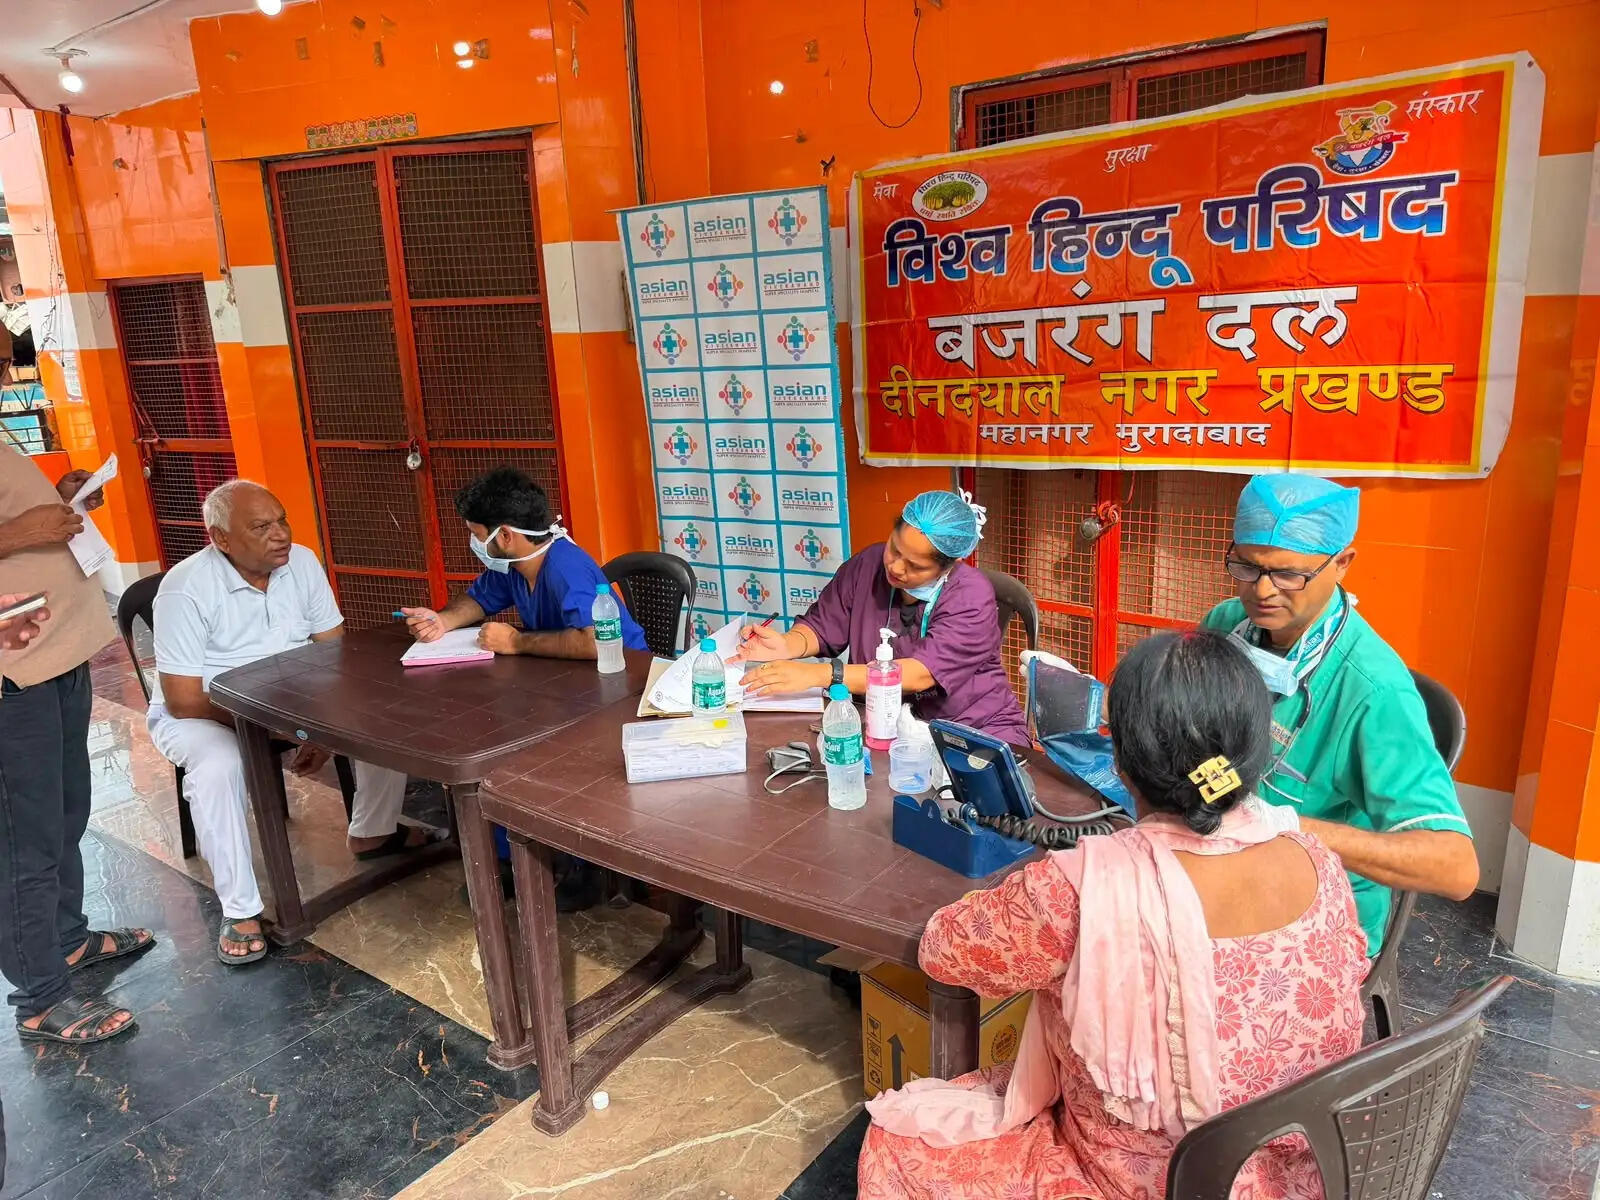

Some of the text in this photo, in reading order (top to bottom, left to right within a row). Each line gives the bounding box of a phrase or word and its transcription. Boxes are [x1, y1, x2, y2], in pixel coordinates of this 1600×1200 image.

[1405, 90, 1483, 121] संस्कार
[1104, 144, 1151, 173] सुरक्षा
[873, 182, 899, 200] सेवा
[693, 216, 746, 233] asian
[883, 162, 1460, 288] विश्व हिन्दू परिषद
[763, 269, 819, 285] asian
[640, 278, 688, 294] asian
[928, 279, 1358, 371] बजरंग दल
[704, 329, 757, 344] asian
[652, 384, 698, 398] asian
[773, 382, 827, 396] asian
[879, 364, 1454, 418] दीनदयाल नगर प्रखण्ड
[715, 435, 765, 449] asian
[980, 423, 1271, 453] महानगर मुरादाबाद
[662, 483, 709, 497] asian
[782, 488, 833, 501] asian
[725, 534, 773, 548] asian
[696, 577, 718, 591] ian
[790, 586, 821, 599] asi
